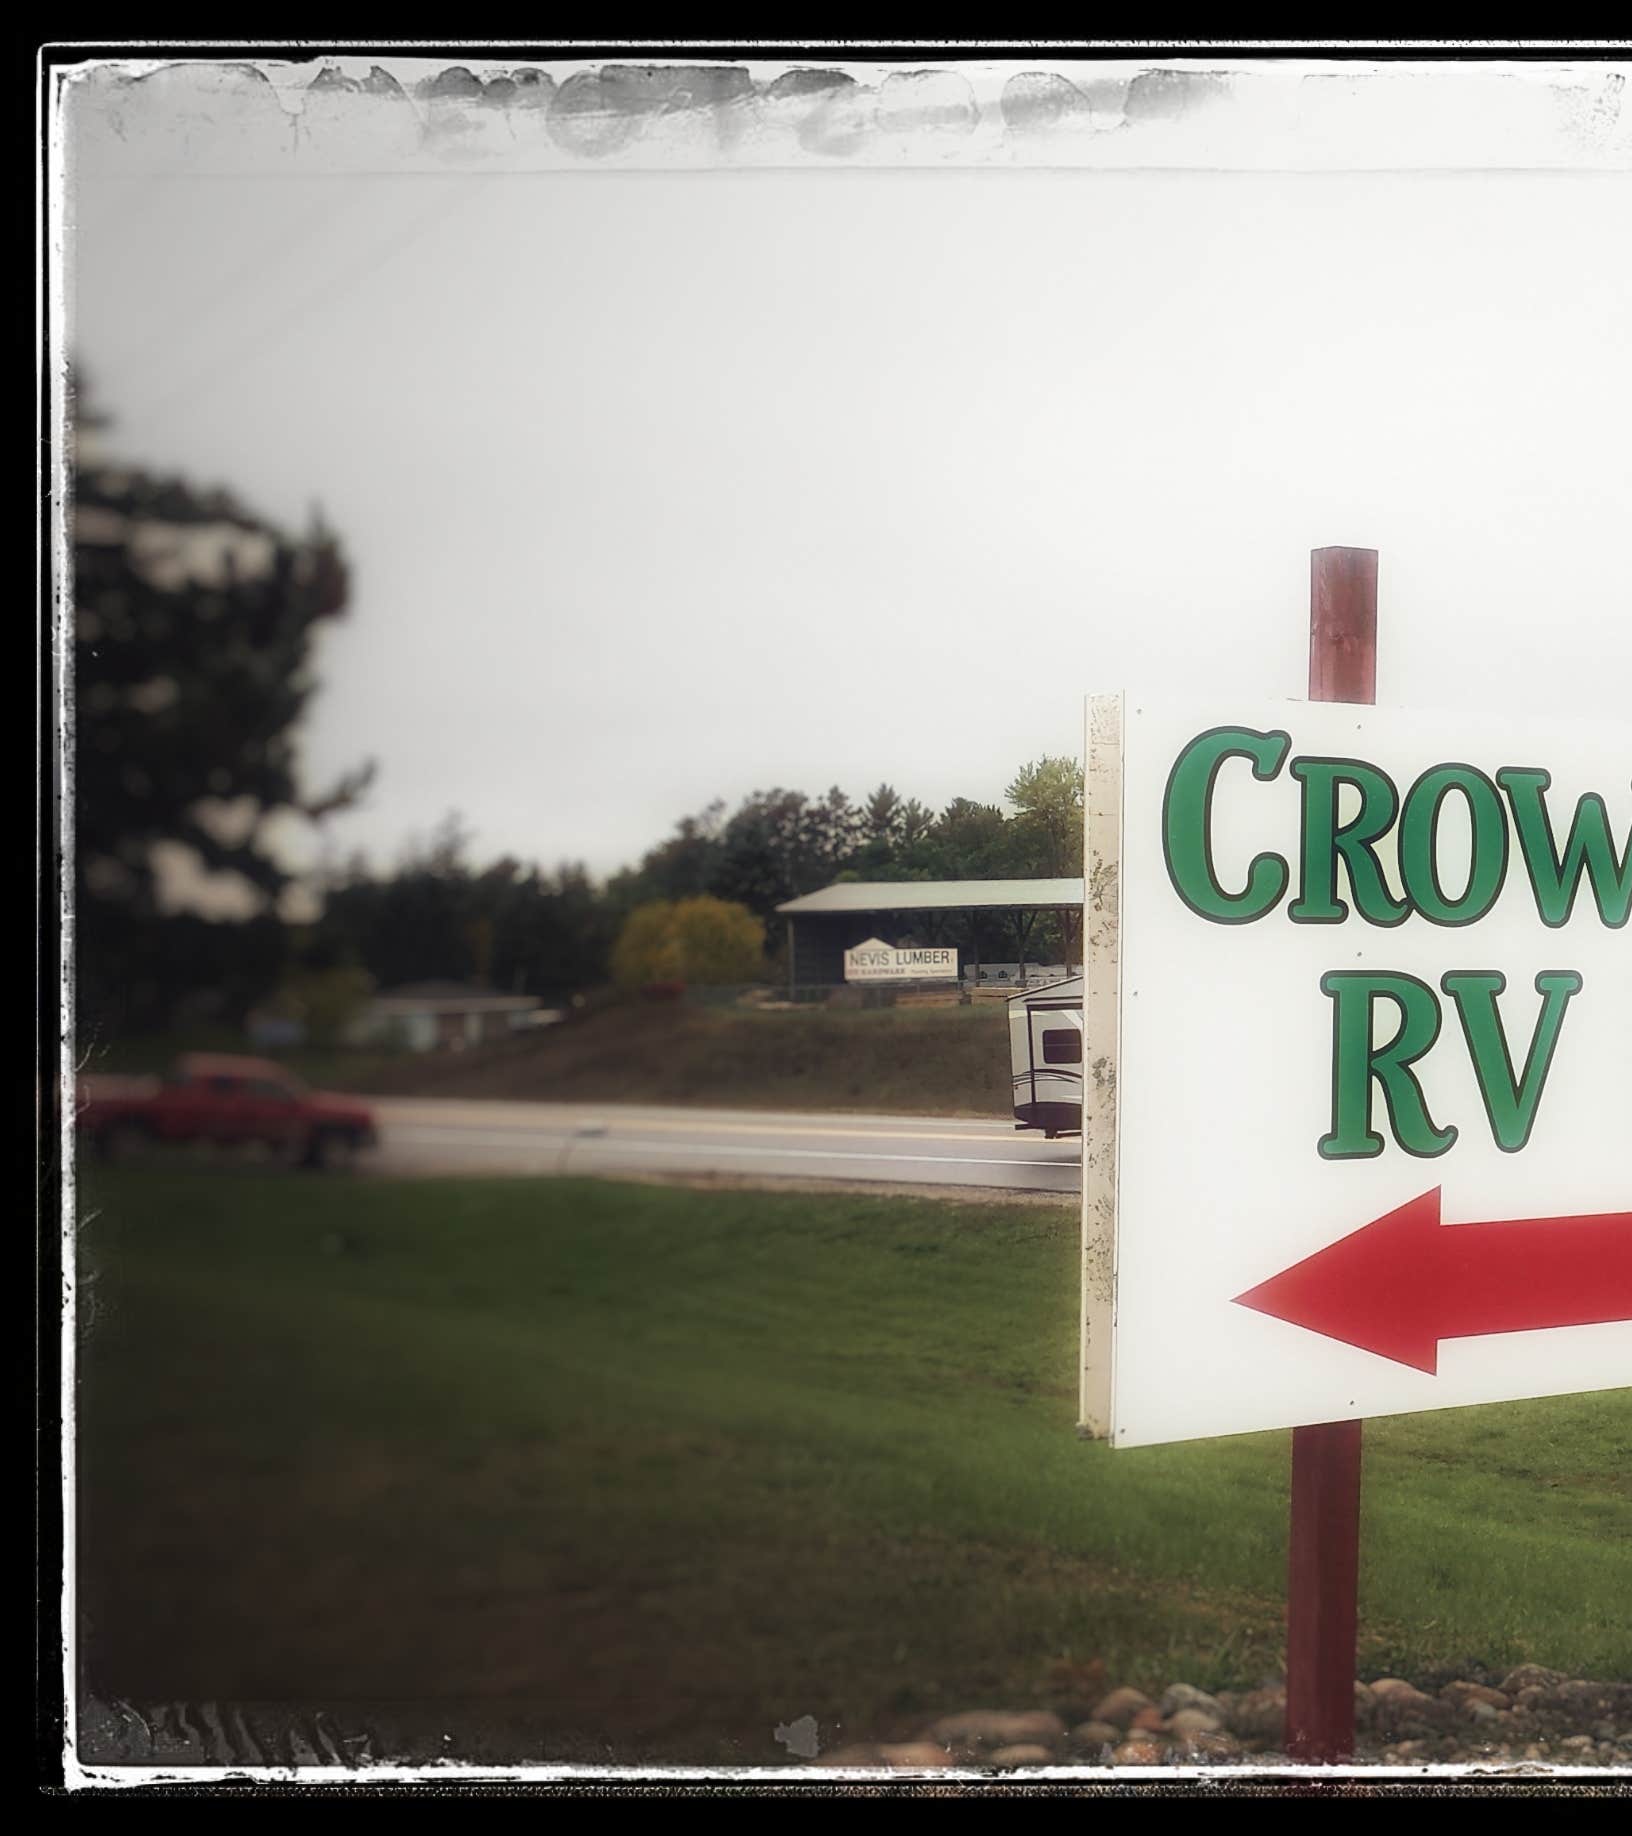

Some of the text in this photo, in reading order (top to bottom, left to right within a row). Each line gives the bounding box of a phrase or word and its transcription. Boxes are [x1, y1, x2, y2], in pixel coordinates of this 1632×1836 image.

[850, 950, 950, 966] NEVIS LUMBER
[1317, 969, 1583, 1160] RV
